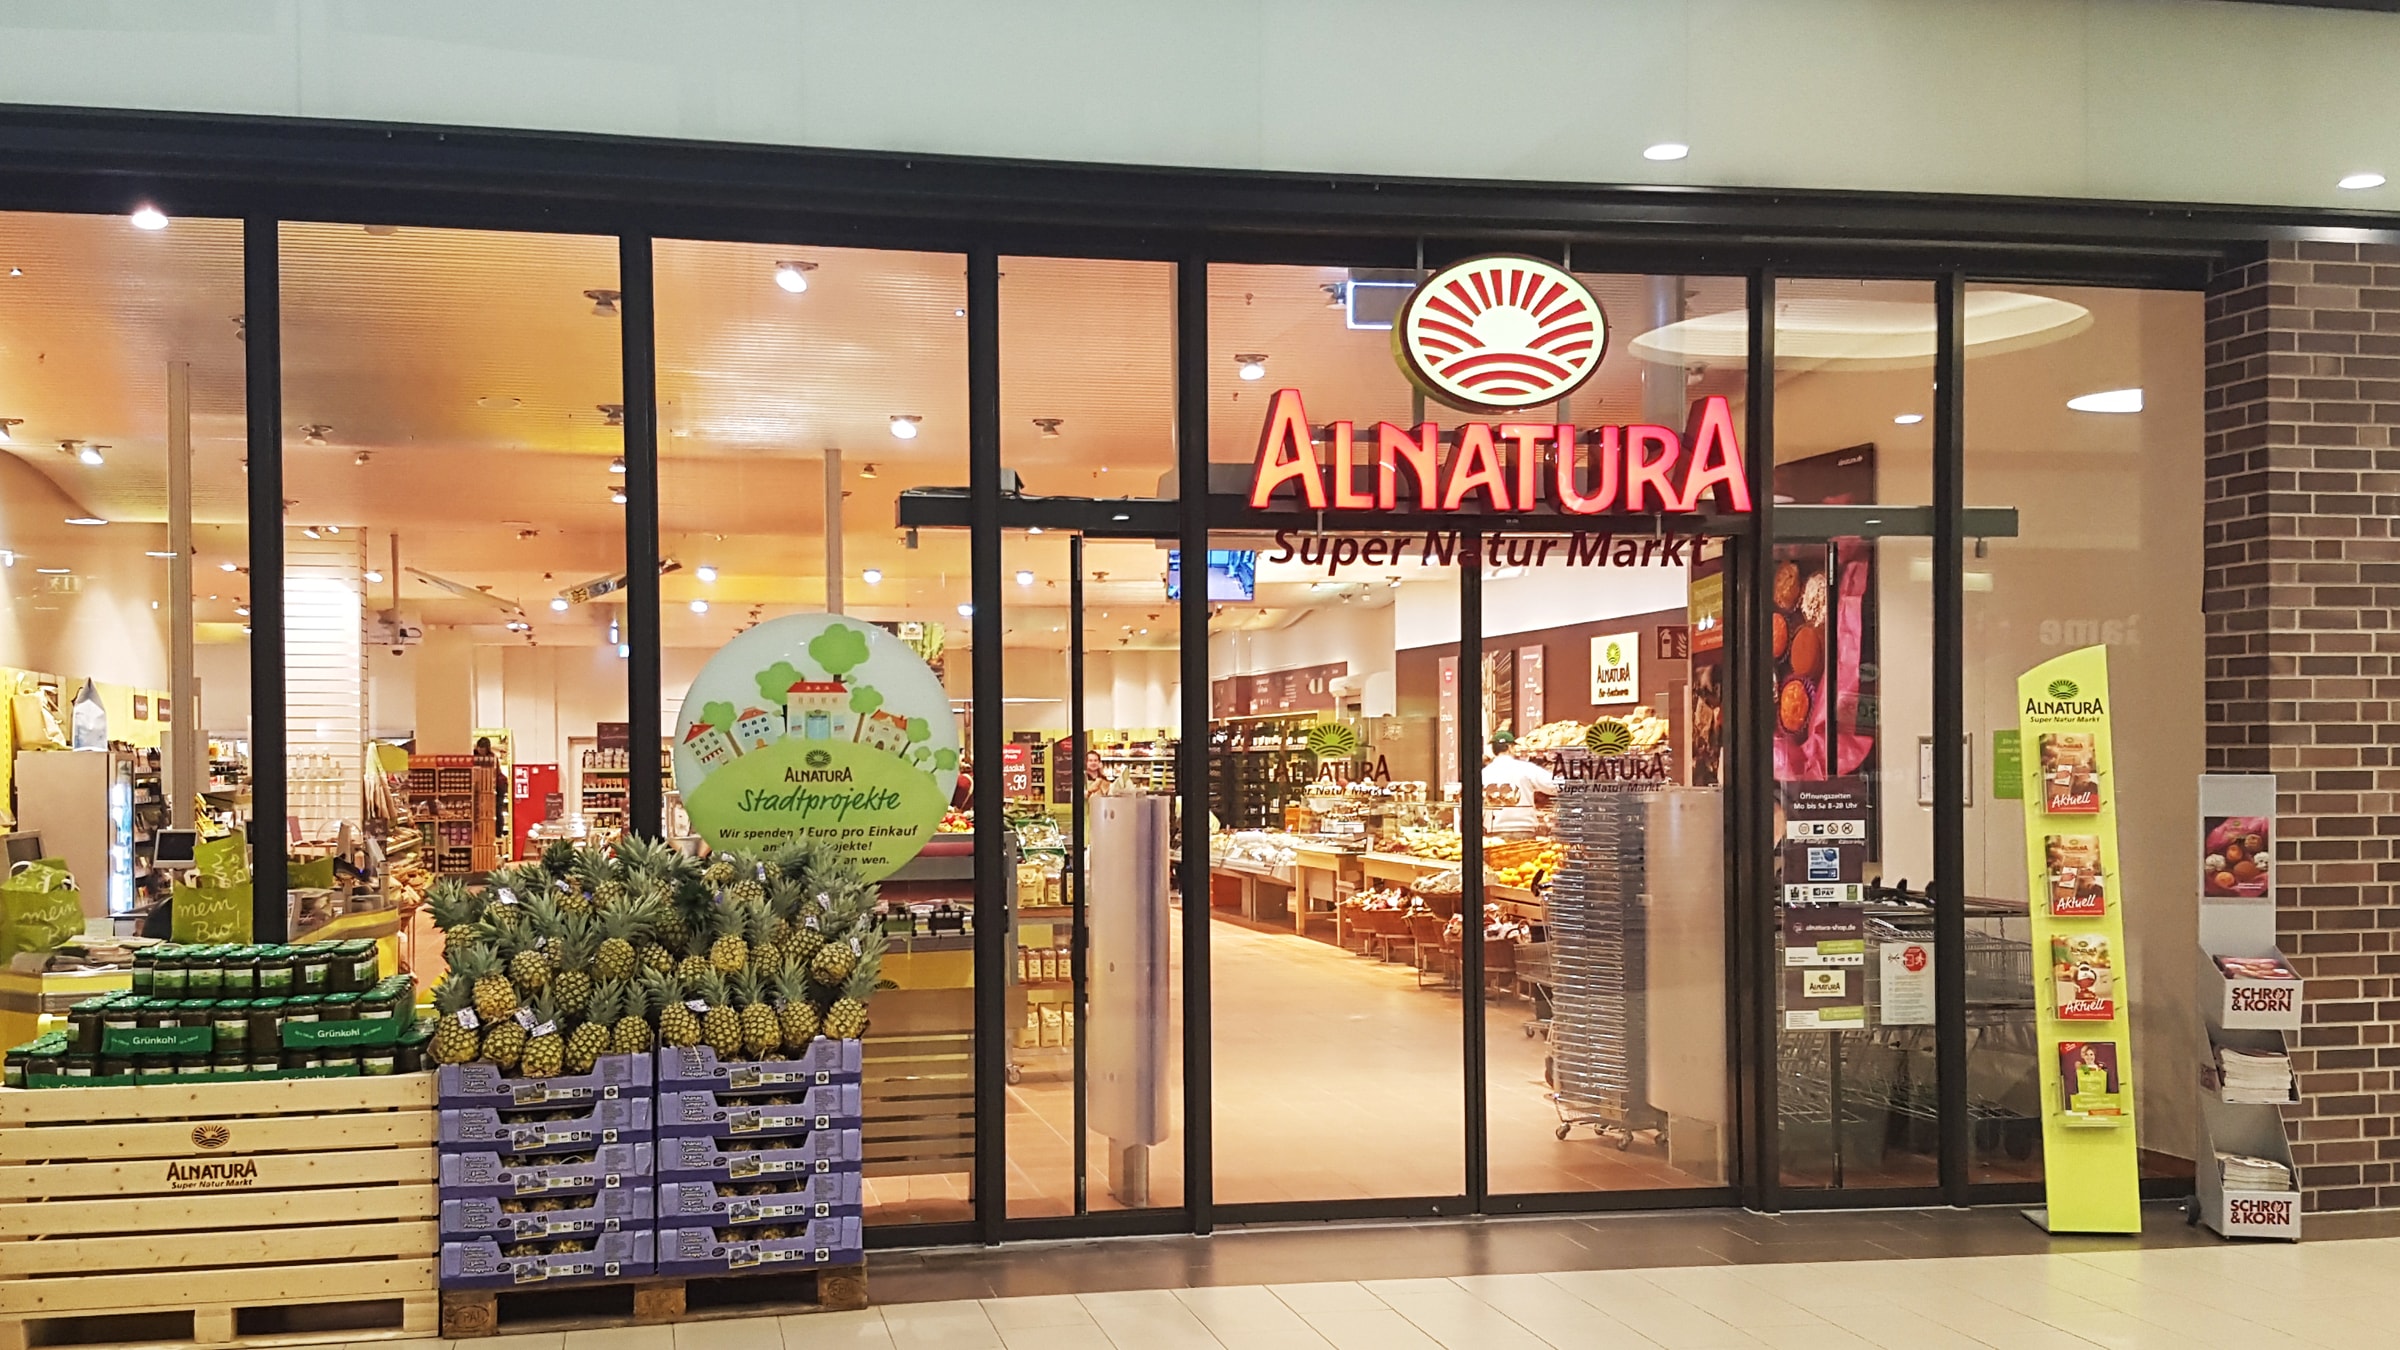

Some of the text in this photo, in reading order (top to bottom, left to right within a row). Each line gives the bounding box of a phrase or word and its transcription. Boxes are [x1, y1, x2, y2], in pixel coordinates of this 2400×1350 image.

[1249, 388, 1752, 514] ALNATURA
[1269, 527, 1708, 576] Super Natur Markt
[2025, 697, 2104, 715] ALNATURA
[2030, 715, 2100, 725] Super Natur Markt
[784, 766, 853, 783] ALNATURA
[1273, 754, 1391, 783] ALATURA
[1552, 752, 1667, 781] ALNATURA
[1557, 784, 1588, 795] Super
[1593, 783, 1623, 793] Natur
[1800, 792, 1851, 801] Öffnungszeiten
[738, 785, 901, 822] Stadtprojekte
[1845, 802, 1858, 810] Uhr
[2051, 792, 2091, 809] Aktuell
[719, 825, 918, 841] Wir spenden 1 Euro pro Einkauf
[862, 855, 890, 865] wen.
[178, 895, 237, 918] mein
[2056, 894, 2096, 912] Aktuell
[2232, 987, 2294, 1000] SCHROT
[2064, 998, 2105, 1016] Aktuell
[132, 1035, 177, 1046] Grünkohl
[317, 1028, 360, 1039] Grünkohl
[166, 1159, 258, 1181] ALNATURA
[171, 1179, 252, 1189] Super Natur Markt
[2230, 1199, 2292, 1212] SCHROT
